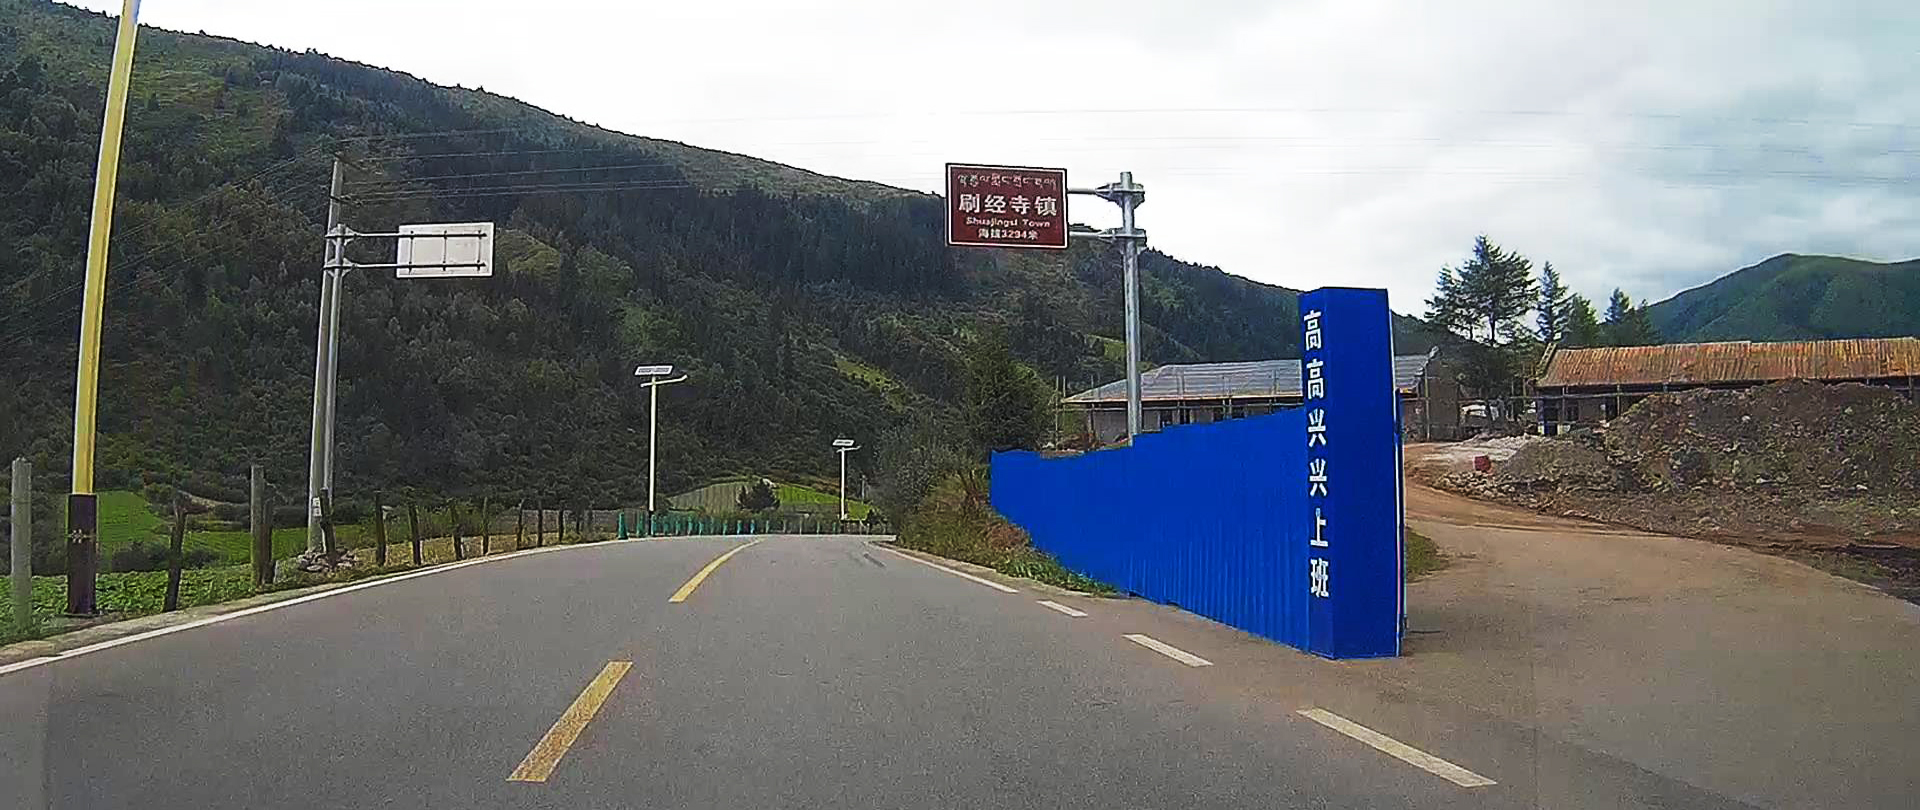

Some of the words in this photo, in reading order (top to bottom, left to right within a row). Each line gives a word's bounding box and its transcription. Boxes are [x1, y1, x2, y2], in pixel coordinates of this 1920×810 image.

[958, 193, 1057, 216] 刷经寺镇
[1022, 218, 1051, 228] Town
[1303, 309, 1329, 598] 高高兴兴上班
